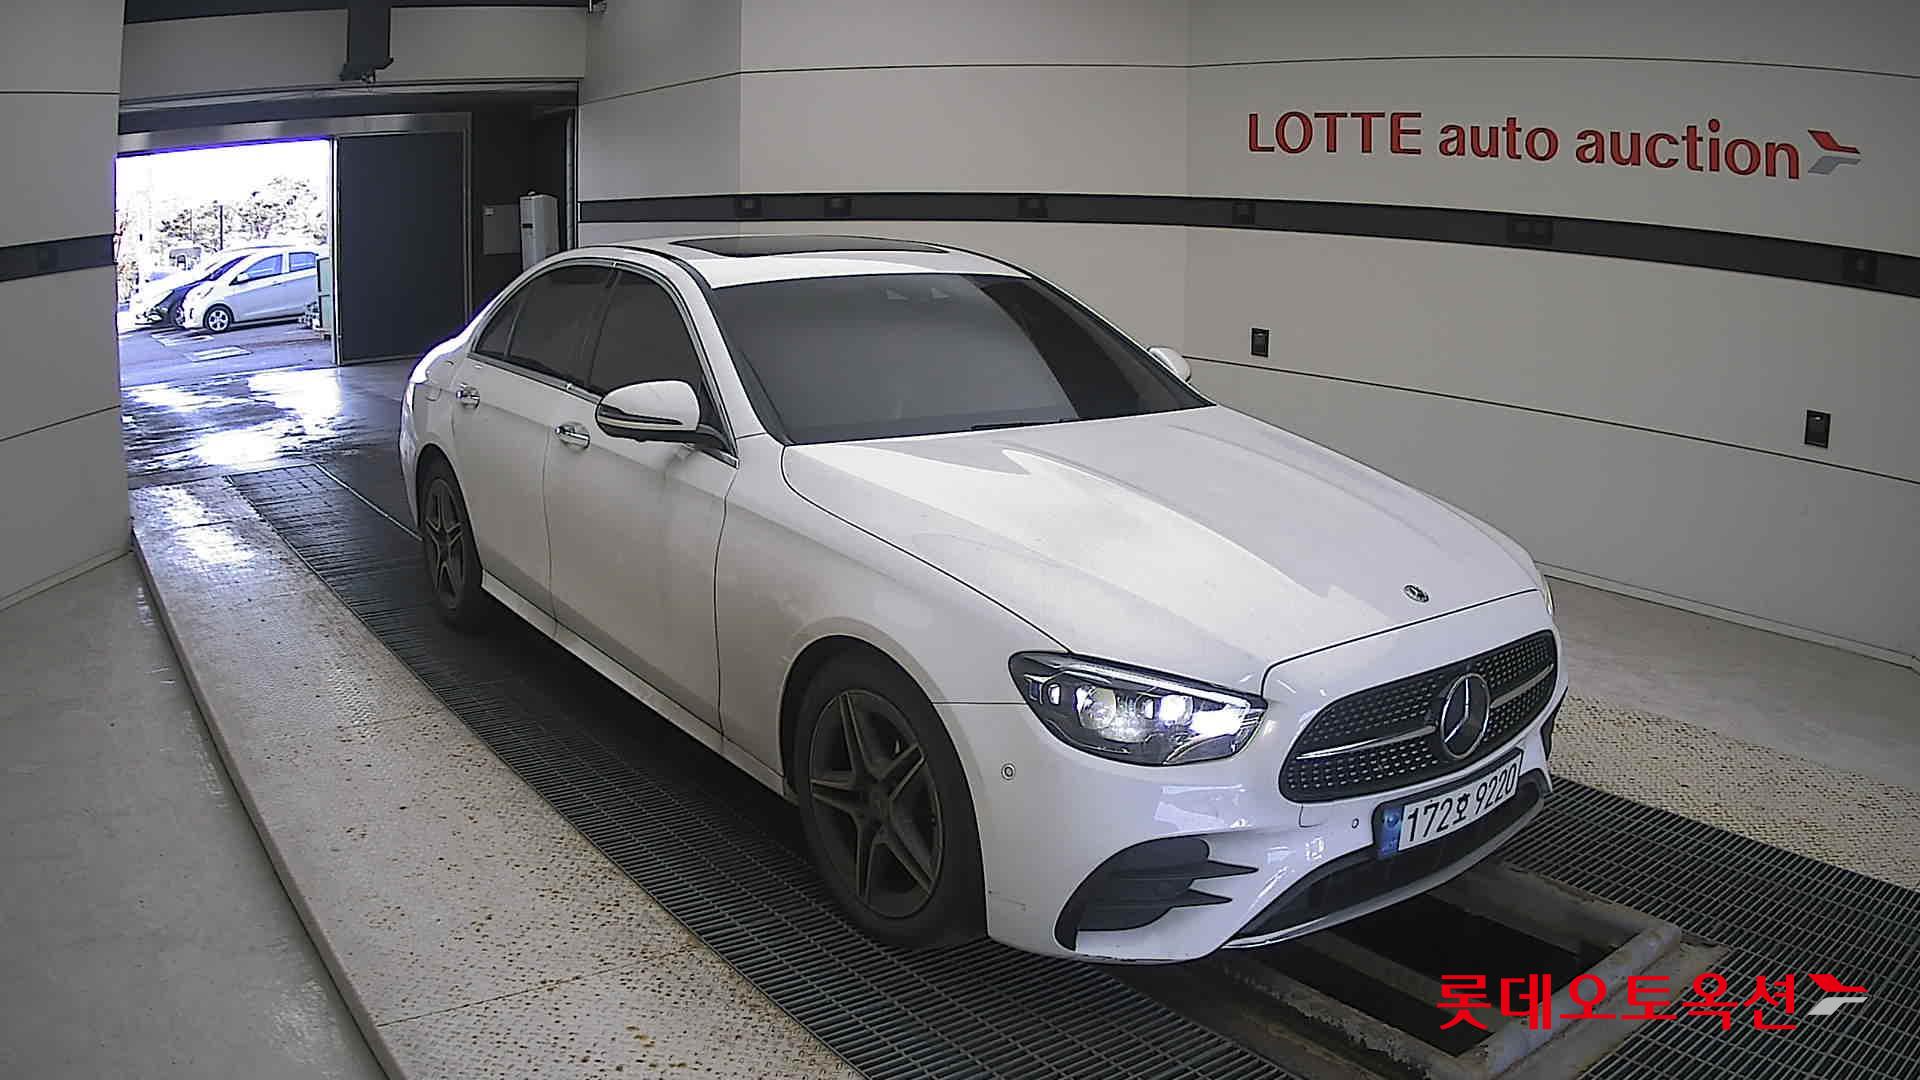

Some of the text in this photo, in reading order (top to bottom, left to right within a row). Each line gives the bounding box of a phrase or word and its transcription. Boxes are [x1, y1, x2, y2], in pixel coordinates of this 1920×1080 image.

[1248, 111, 1801, 180] LOTTE auto auction
[1475, 763, 1517, 815] 9220
